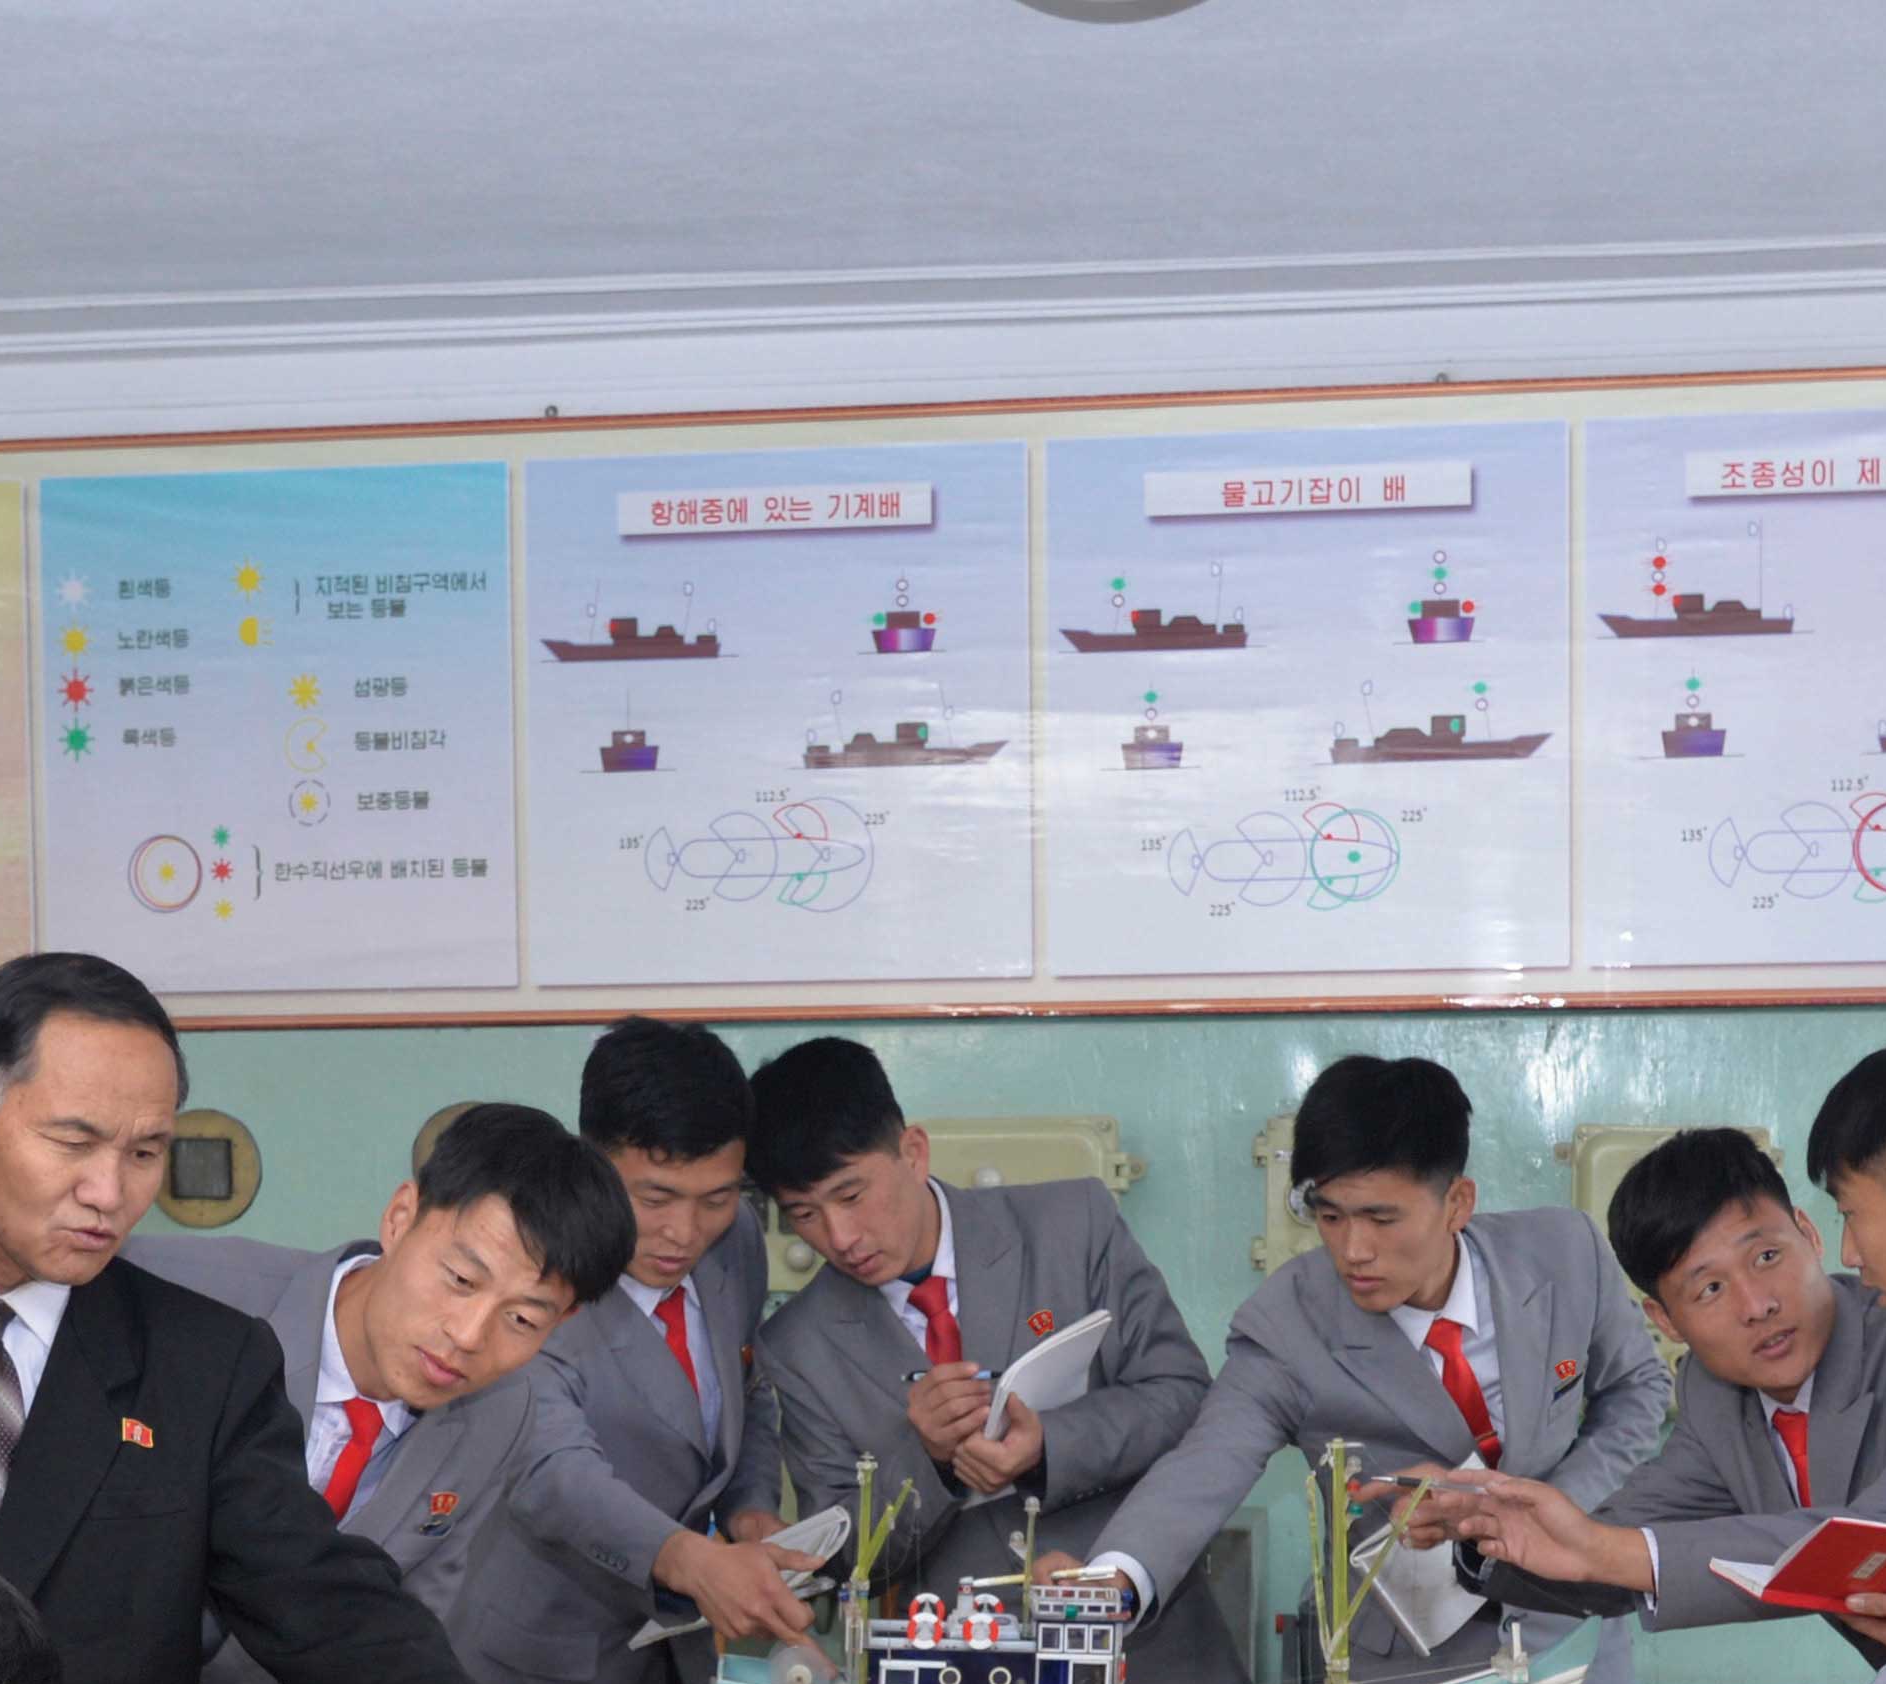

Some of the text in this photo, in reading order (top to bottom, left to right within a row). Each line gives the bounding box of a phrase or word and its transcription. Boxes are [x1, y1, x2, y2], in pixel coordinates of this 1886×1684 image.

[1720, 460, 1836, 490] 조종성이
[1221, 474, 1408, 508] 물고기잡이 배
[650, 491, 902, 526] 항해중에 있는 기계배
[118, 577, 172, 600] 흰색등
[315, 575, 368, 596] 지적된
[327, 600, 363, 619] 보는
[118, 628, 190, 650] 노란색등
